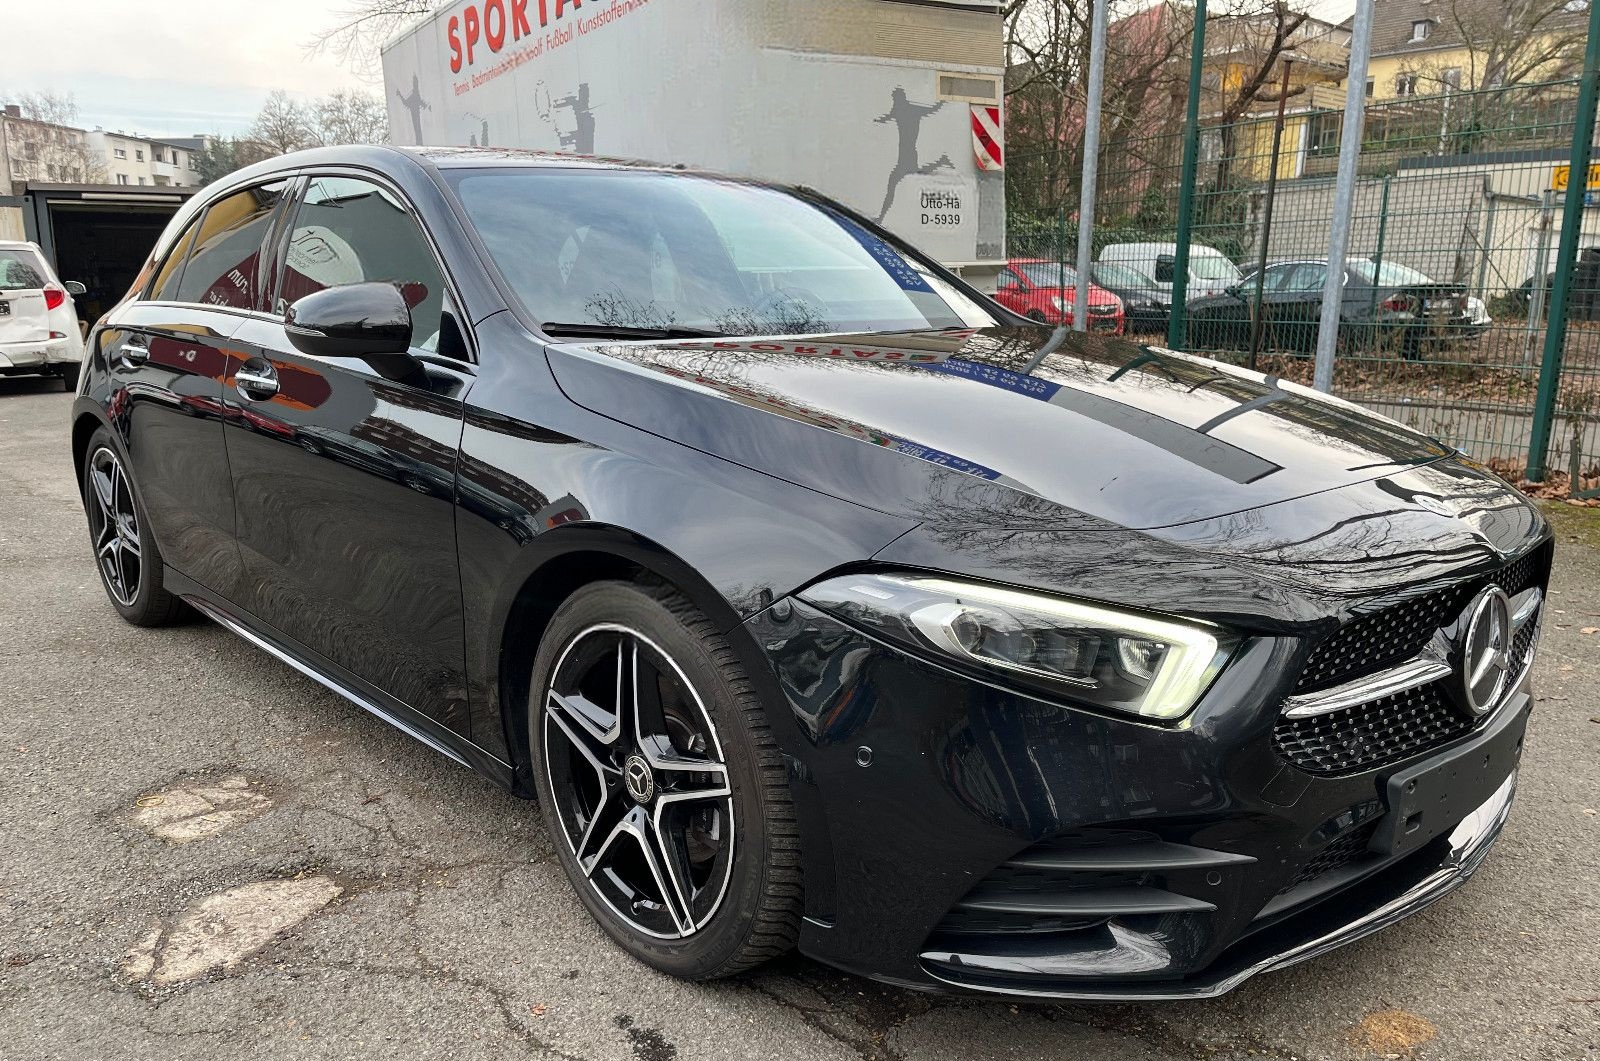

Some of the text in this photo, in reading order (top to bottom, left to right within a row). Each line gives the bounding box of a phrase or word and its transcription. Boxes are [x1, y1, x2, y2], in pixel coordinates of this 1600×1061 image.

[448, 0, 604, 74] SPOR
[453, 78, 469, 96] Tennis
[546, 23, 573, 50] Fußball
[921, 214, 960, 225] D-5939
